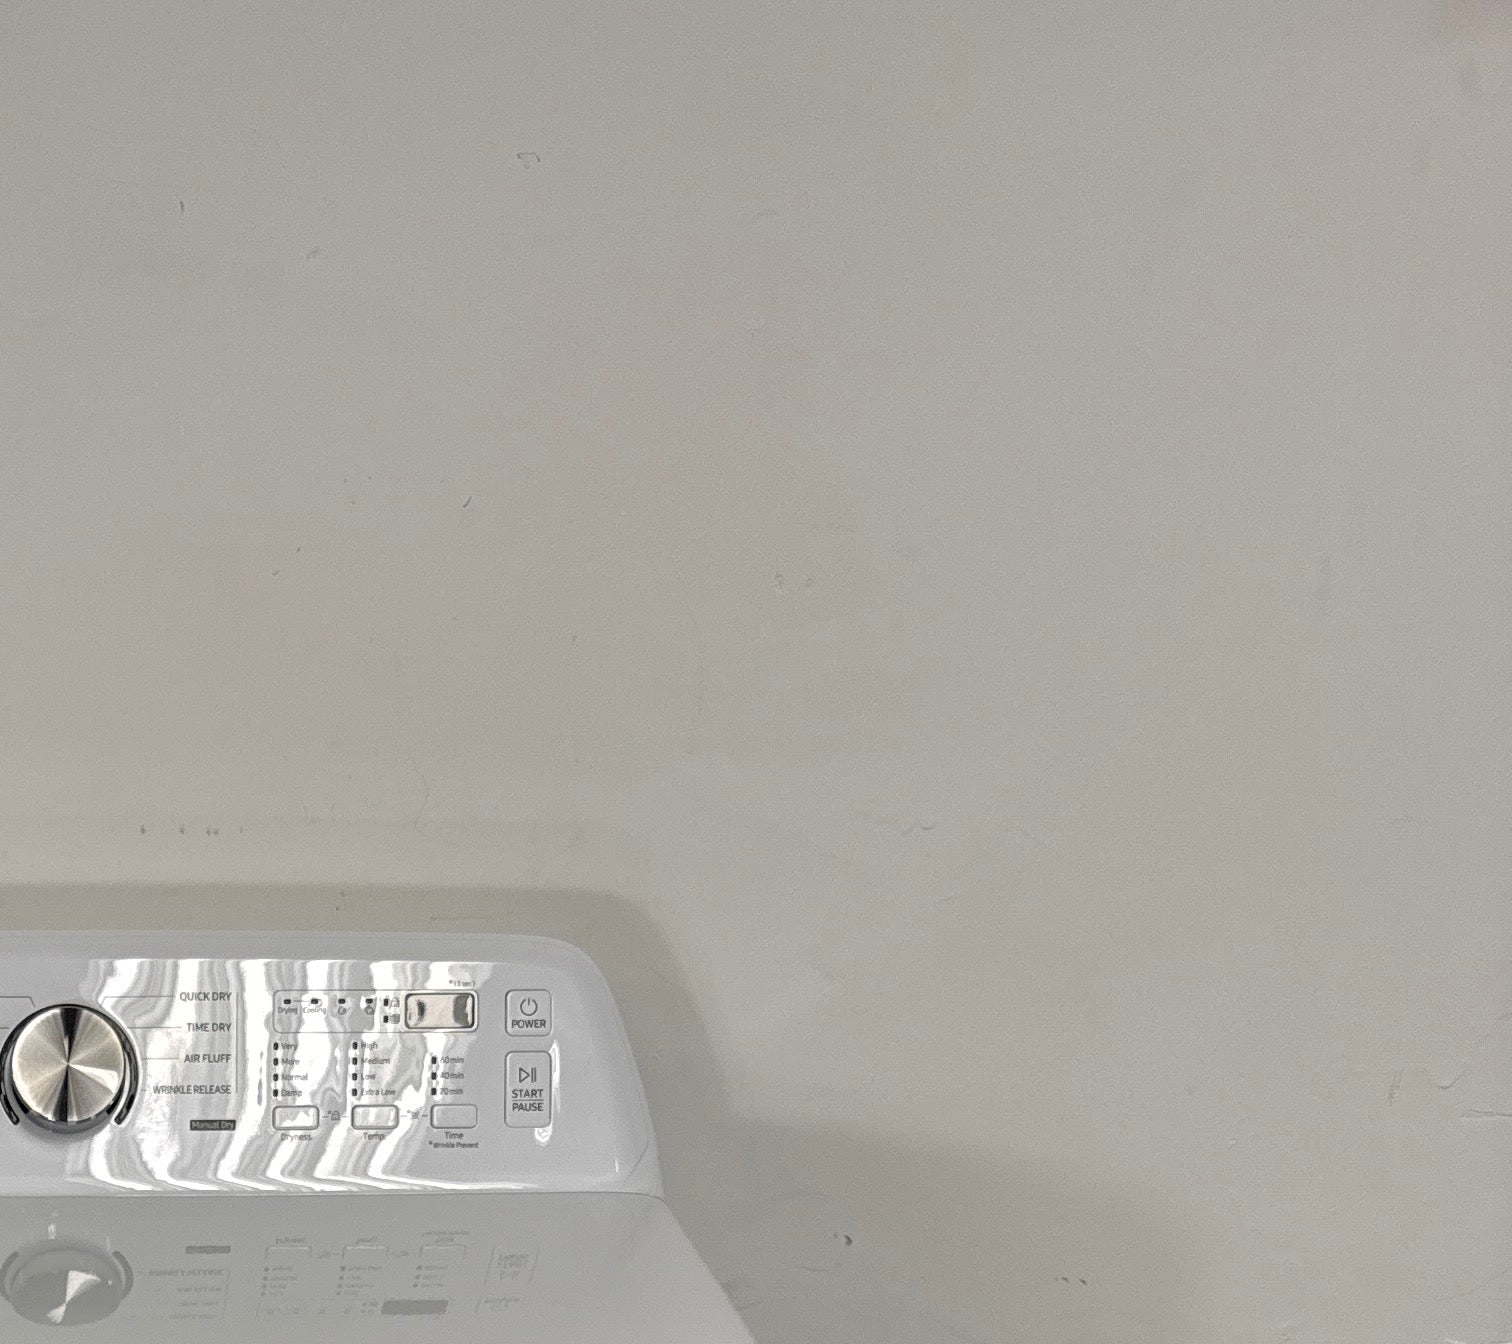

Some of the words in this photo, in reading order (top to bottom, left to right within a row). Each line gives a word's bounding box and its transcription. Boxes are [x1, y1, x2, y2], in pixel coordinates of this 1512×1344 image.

[180, 992, 210, 1002] QUICK
[212, 992, 232, 1001] DRY
[187, 1023, 210, 1032] TIME
[212, 1023, 232, 1032] DRY
[511, 1020, 546, 1029] POWER
[184, 1054, 201, 1063] AIR
[202, 1054, 232, 1063] FLUFF
[439, 1071, 450, 1080] 40
[153, 1085, 192, 1095] WRINKLE
[193, 1085, 232, 1095] RELEASE
[511, 1089, 544, 1099] START
[512, 1102, 544, 1112] PAUSE
[444, 1131, 465, 1140] Time
